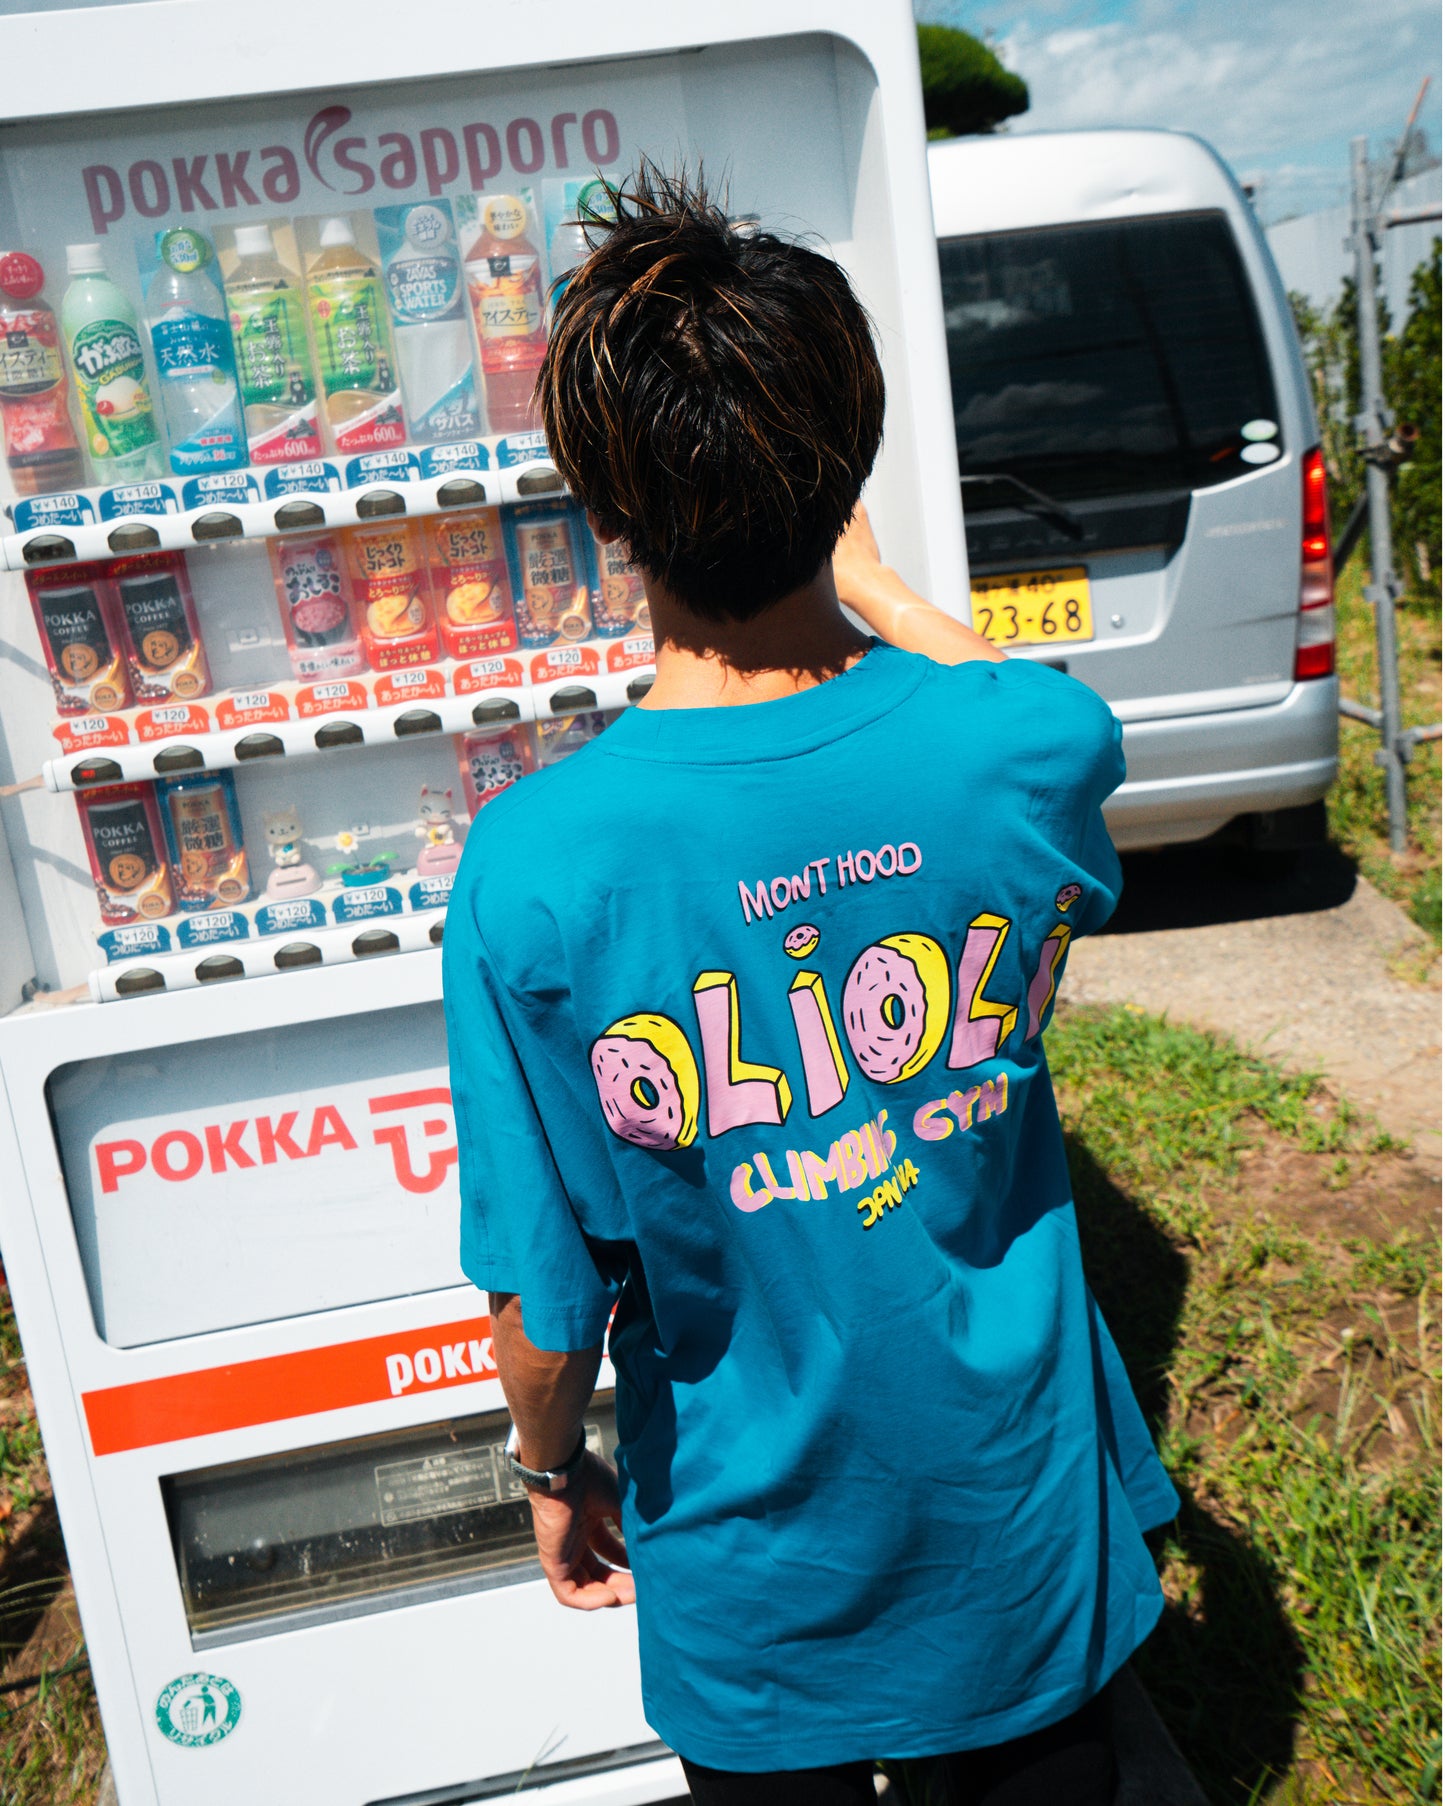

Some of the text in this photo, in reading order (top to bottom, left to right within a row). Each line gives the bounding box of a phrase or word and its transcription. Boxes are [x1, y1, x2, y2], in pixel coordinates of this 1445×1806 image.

[400, 279, 447, 297] SPORTS
[402, 293, 446, 309] WATER
[482, 308, 538, 325] アイスティー
[355, 303, 376, 365] 玉露入り
[161, 342, 219, 366] 天然水
[264, 316, 286, 377] 玉露入り
[337, 327, 361, 375] お茶
[248, 341, 272, 389] お茶
[436, 413, 474, 431] ザバス
[450, 530, 486, 545] じっくり
[366, 542, 403, 559] じっくり
[449, 544, 488, 558] コトコト
[528, 548, 567, 568] 厳選
[367, 558, 405, 571] コトコト
[531, 566, 570, 585] 微糖
[126, 597, 177, 614] POKKA
[45, 610, 97, 627] POKKA
[134, 611, 171, 625] COFFEE
[978, 599, 1082, 641] 23-68
[53, 624, 89, 636] COFFEE
[93, 822, 145, 839] POKKA
[182, 815, 221, 834] 厳選
[102, 836, 138, 848] COFFEE
[184, 833, 224, 852] 微糖
[738, 842, 923, 925] MONT HOOD
[913, 1072, 1009, 1141] GYM
[95, 1105, 358, 1193] POKKA
